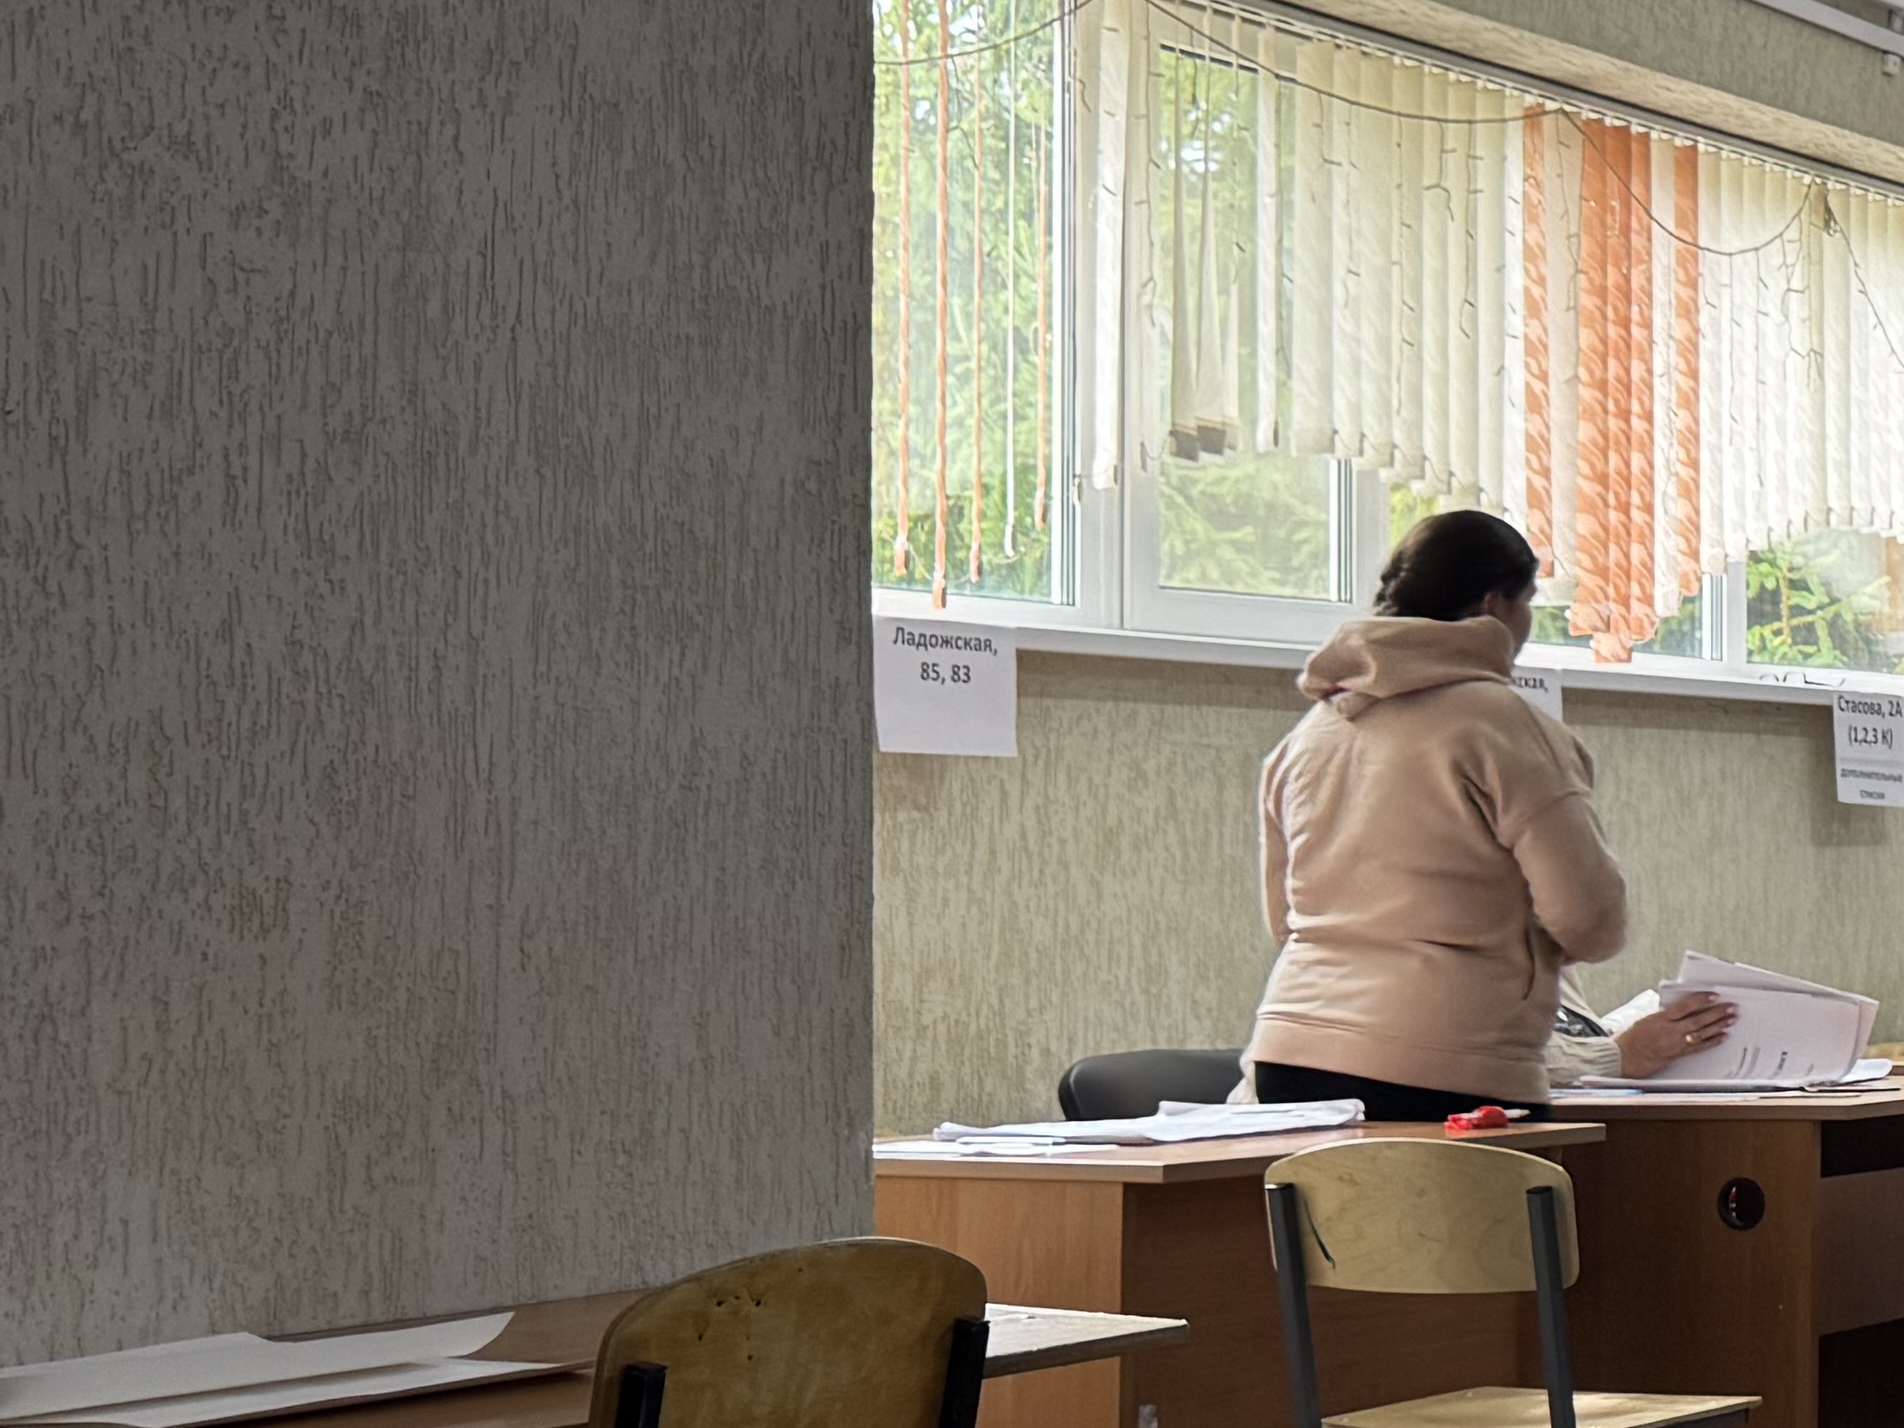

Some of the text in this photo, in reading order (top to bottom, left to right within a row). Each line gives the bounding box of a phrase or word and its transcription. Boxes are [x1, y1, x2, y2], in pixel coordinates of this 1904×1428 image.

[892, 626, 998, 656] Ладожская,
[920, 661, 972, 685] 85, 83
[1837, 695, 1903, 719] Стасова, 2А
